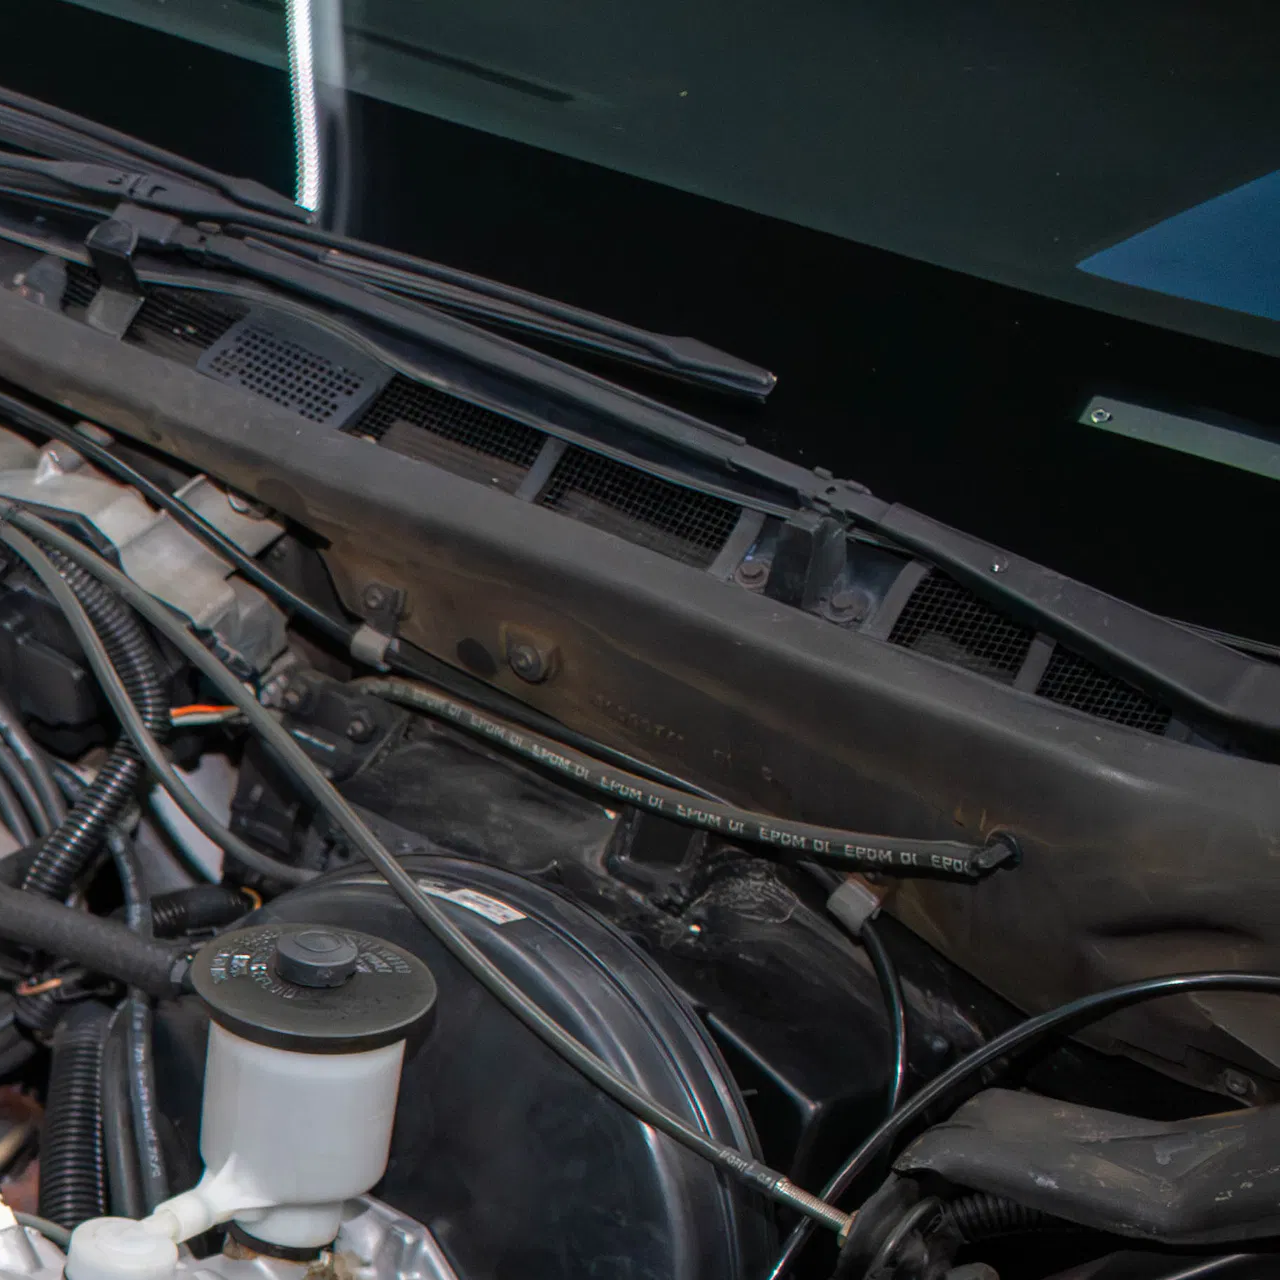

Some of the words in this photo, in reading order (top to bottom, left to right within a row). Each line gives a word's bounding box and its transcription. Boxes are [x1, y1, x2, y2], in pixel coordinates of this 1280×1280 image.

[674, 801, 722, 829] EPDM
[759, 827, 806, 848] EPDM
[844, 844, 893, 863] EPDM
